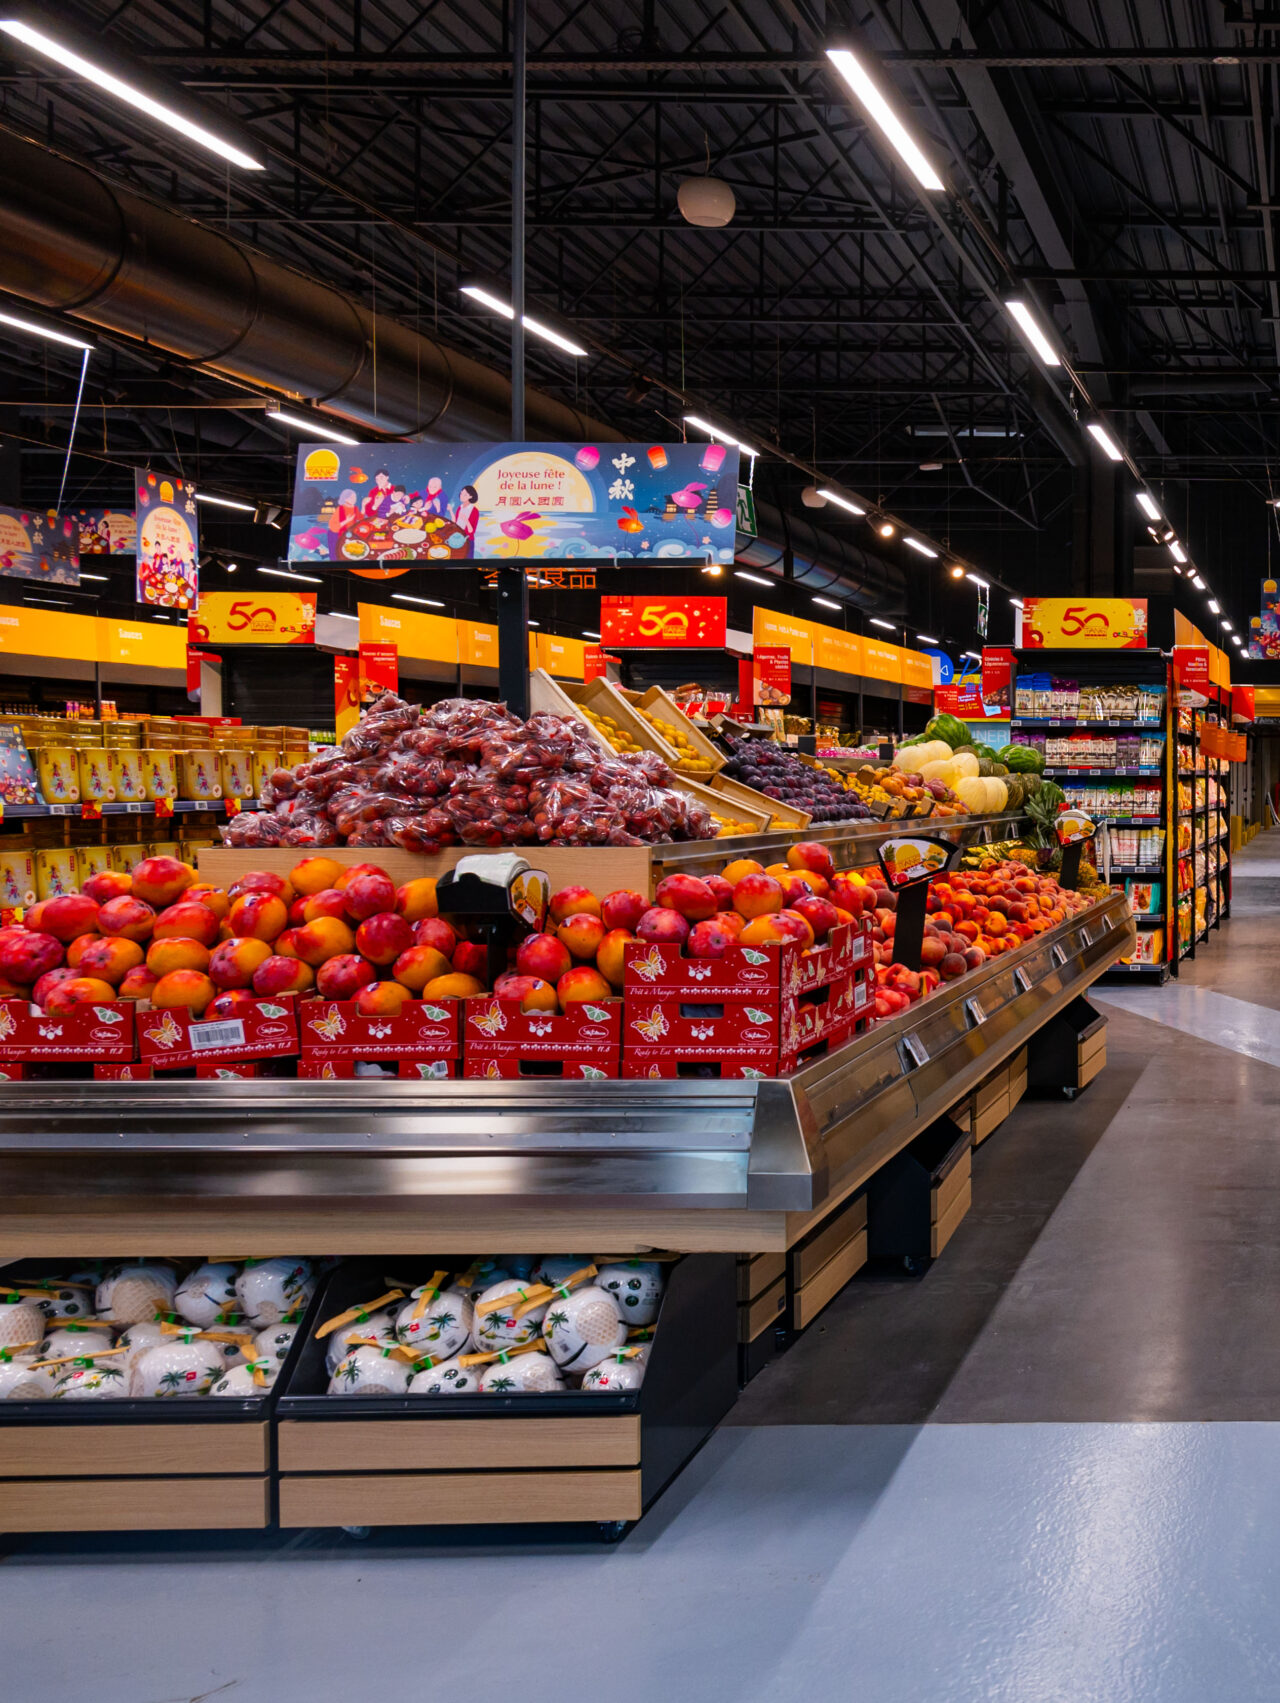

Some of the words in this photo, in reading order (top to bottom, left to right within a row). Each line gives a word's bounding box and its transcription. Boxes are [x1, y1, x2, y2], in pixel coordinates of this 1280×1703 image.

[498, 469, 540, 481] Joyeuse
[544, 468, 565, 479] fête
[500, 480, 514, 490] de
[518, 480, 527, 490] la
[530, 480, 554, 490] lune
[608, 452, 636, 501] 中秋
[227, 601, 277, 631] 50
[638, 605, 688, 636] 50
[1061, 607, 1109, 636] 50
